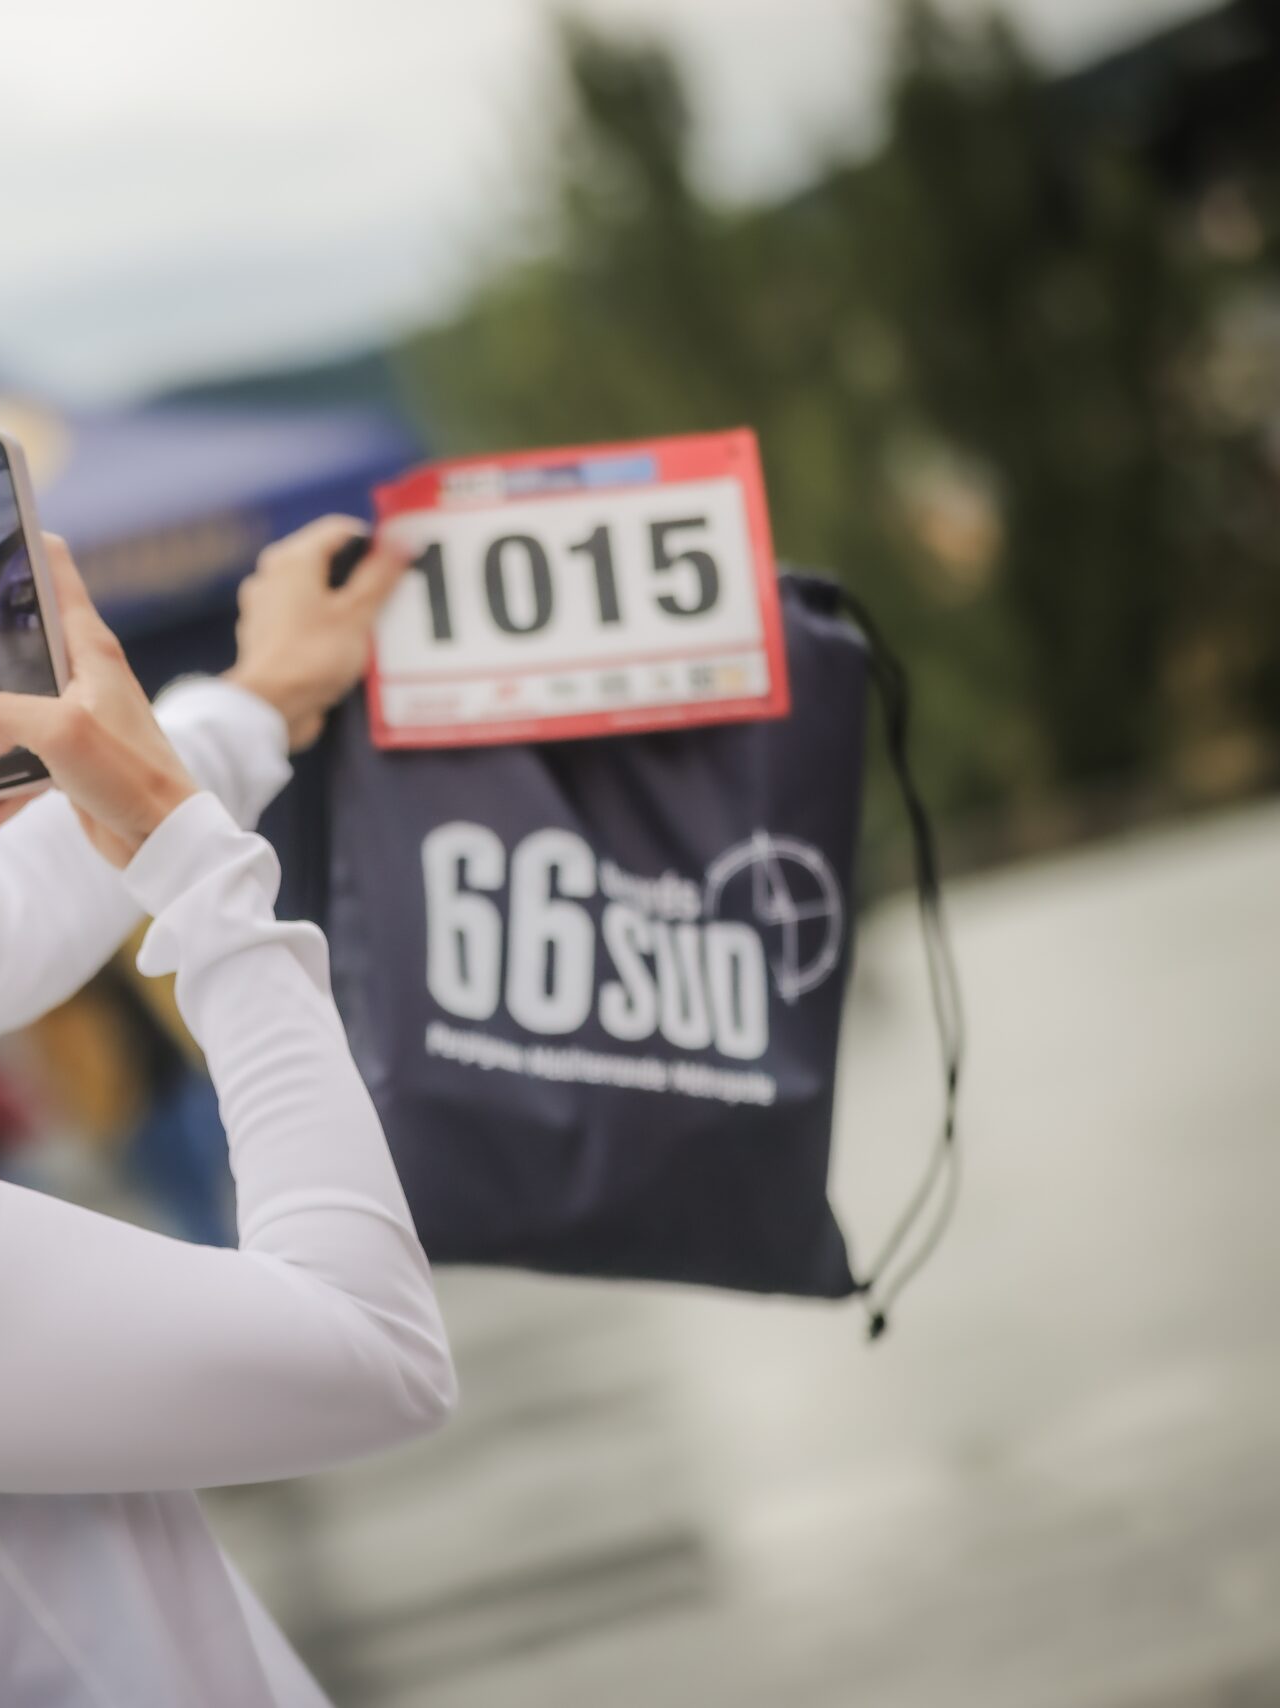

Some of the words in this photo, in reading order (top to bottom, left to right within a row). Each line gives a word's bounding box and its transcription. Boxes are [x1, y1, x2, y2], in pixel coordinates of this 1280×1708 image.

[413, 516, 720, 641] 1015
[421, 820, 596, 1035] 66
[598, 903, 770, 1061] SUD
